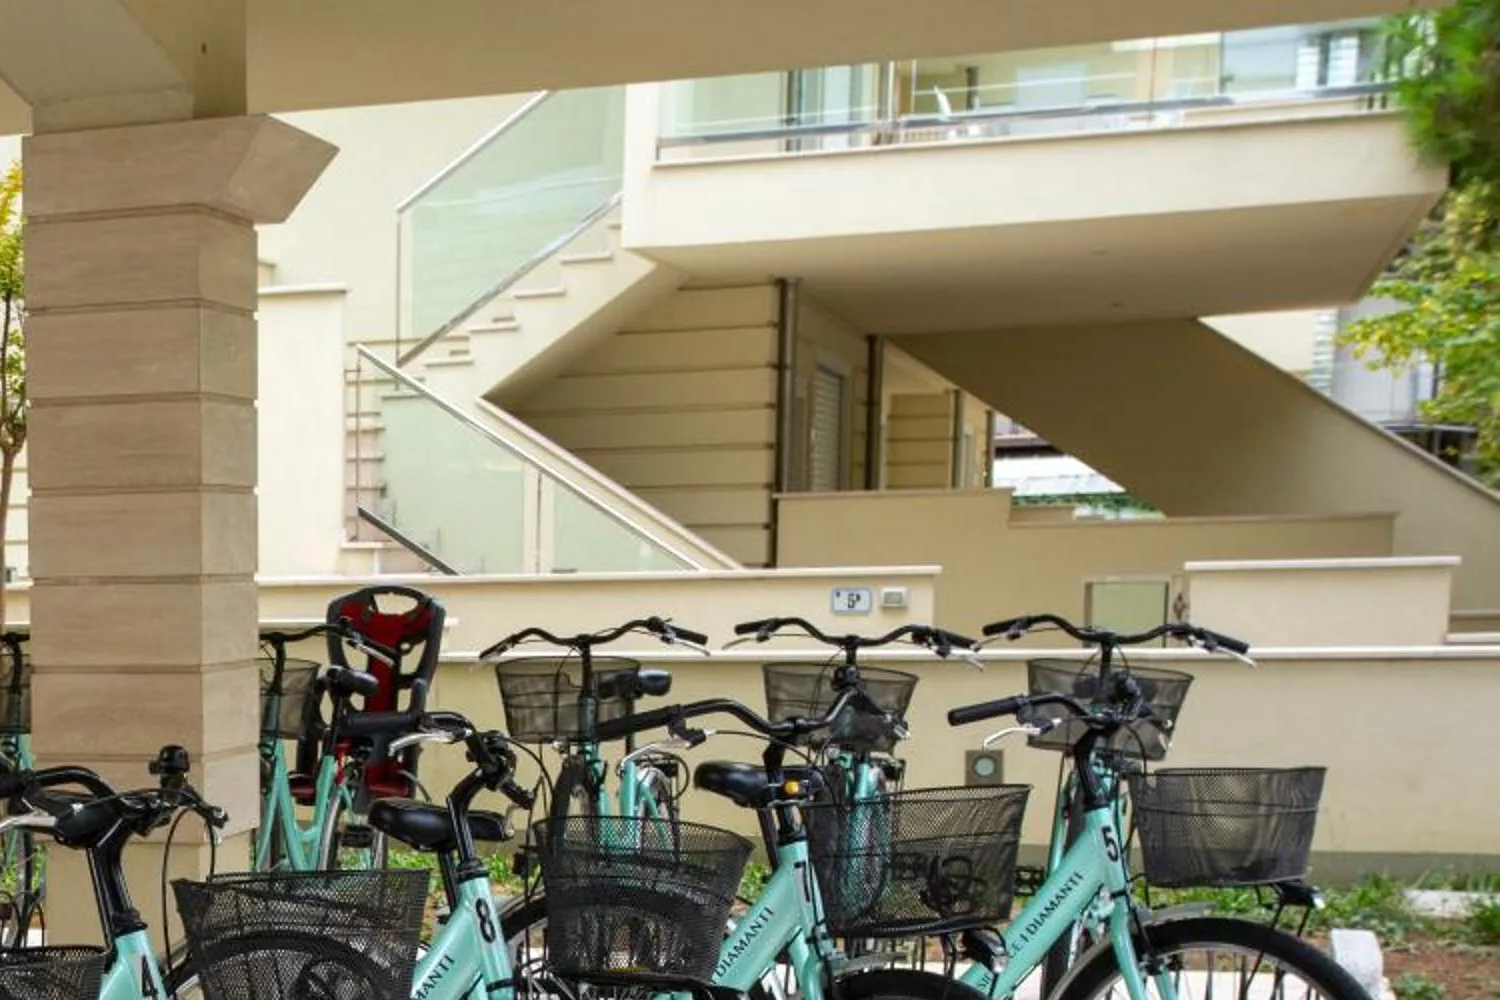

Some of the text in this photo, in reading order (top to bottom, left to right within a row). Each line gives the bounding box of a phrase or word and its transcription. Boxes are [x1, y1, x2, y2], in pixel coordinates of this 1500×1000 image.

[1101, 826, 1119, 863] 5
[475, 898, 496, 943] 8
[1025, 871, 1084, 935] DIAMANTI
